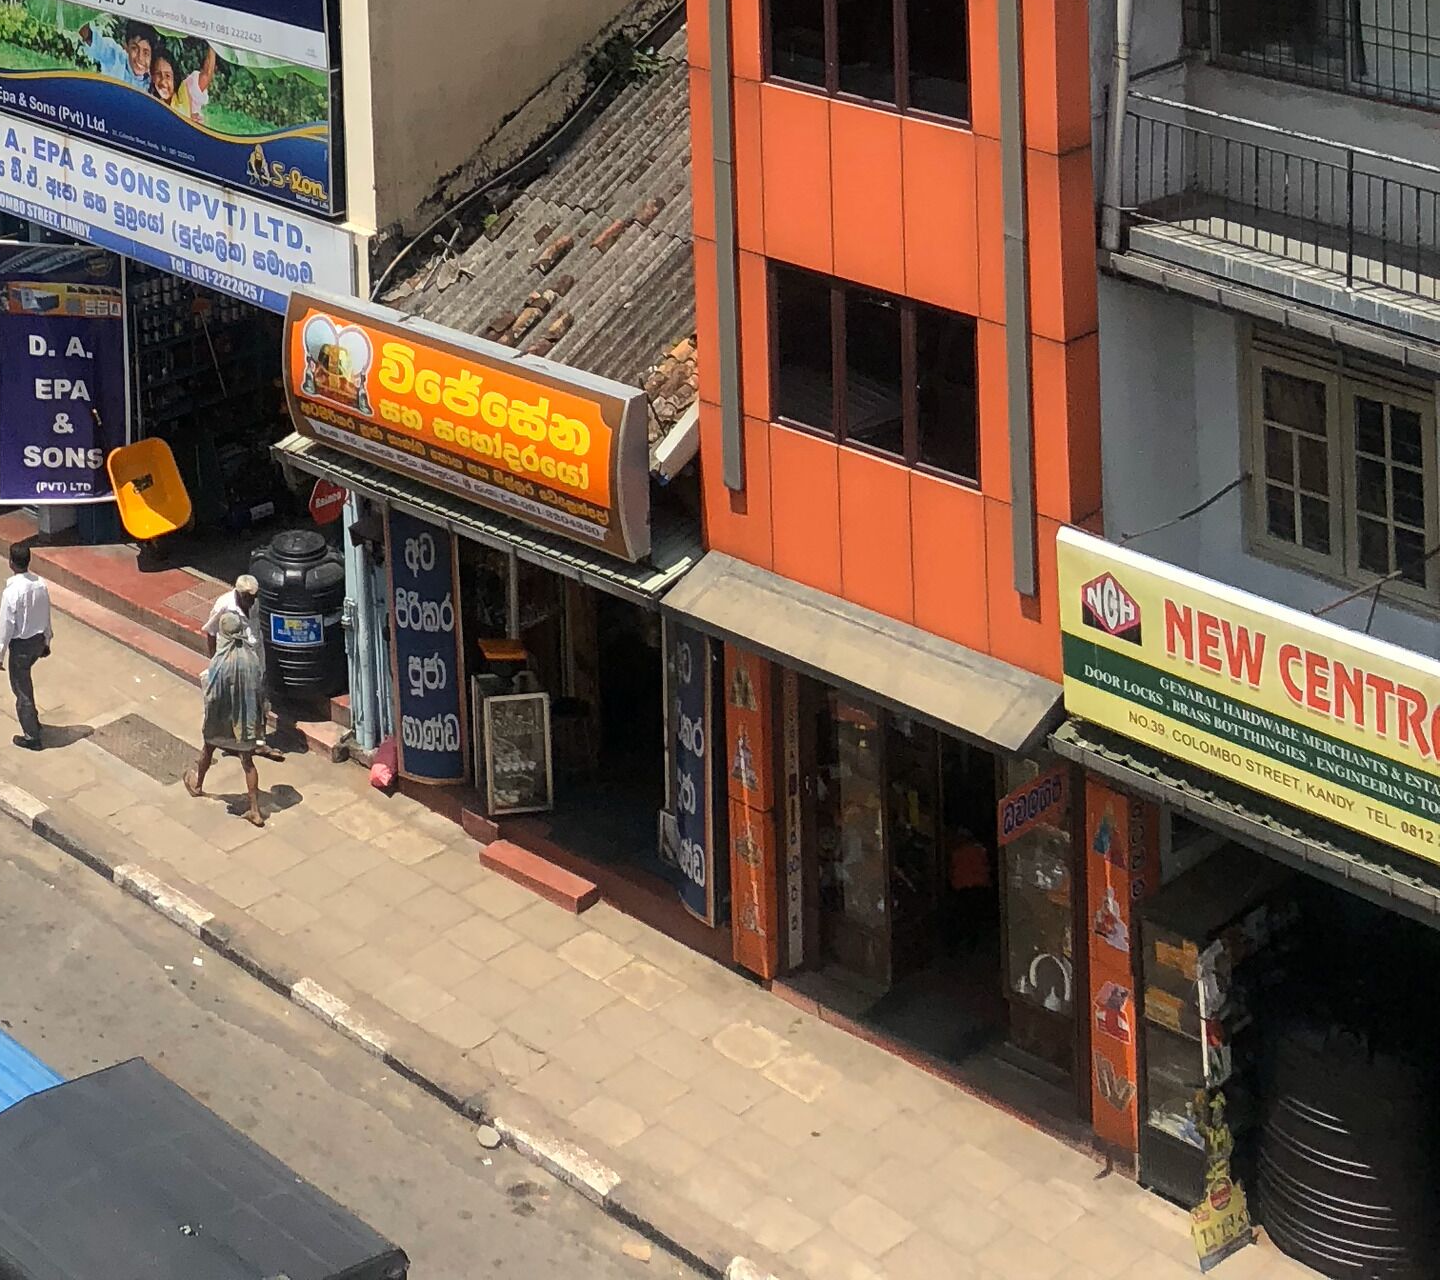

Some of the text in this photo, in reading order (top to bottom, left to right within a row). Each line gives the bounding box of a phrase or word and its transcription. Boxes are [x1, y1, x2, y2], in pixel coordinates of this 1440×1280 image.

[18, 93, 27, 107] &
[29, 96, 57, 117] Sons
[58, 105, 84, 129] (Pvt)
[86, 114, 109, 134] Ltd.
[4, 127, 27, 154] A.
[33, 135, 74, 171] EPA
[81, 153, 97, 179] &
[104, 161, 171, 203] SONS
[178, 186, 247, 232] (PVT)
[253, 211, 312, 254] LTD.
[83, 189, 107, 214] සහ
[27, 203, 60, 228] STREET,
[28, 334, 93, 359] D. A.
[35, 378, 91, 401] EPA
[378, 342, 591, 456] විජේසේන
[52, 412, 74, 434] &
[379, 398, 423, 431] සහ
[23, 445, 103, 470] SONS
[36, 481, 92, 494] (PVT) LTD
[405, 532, 435, 578] අට
[395, 587, 454, 633] පිරිකර
[1164, 597, 1267, 687] NEW
[1084, 664, 1121, 689] DOOR
[1124, 680, 1164, 705] LOCKS
[1172, 699, 1211, 726] BRASS
[1213, 717, 1307, 763] BOTTHINGIES
[1316, 757, 1415, 805] ENGINEERING
[1418, 796, 1440, 815] TO
[1159, 676, 1220, 711] GENARAL
[1223, 701, 1300, 742] HARDWARE
[1303, 733, 1388, 780] MERCHANTS
[1391, 767, 1401, 781] &
[1172, 728, 1242, 767] COLOMBO
[1401, 820, 1434, 844] 0812
